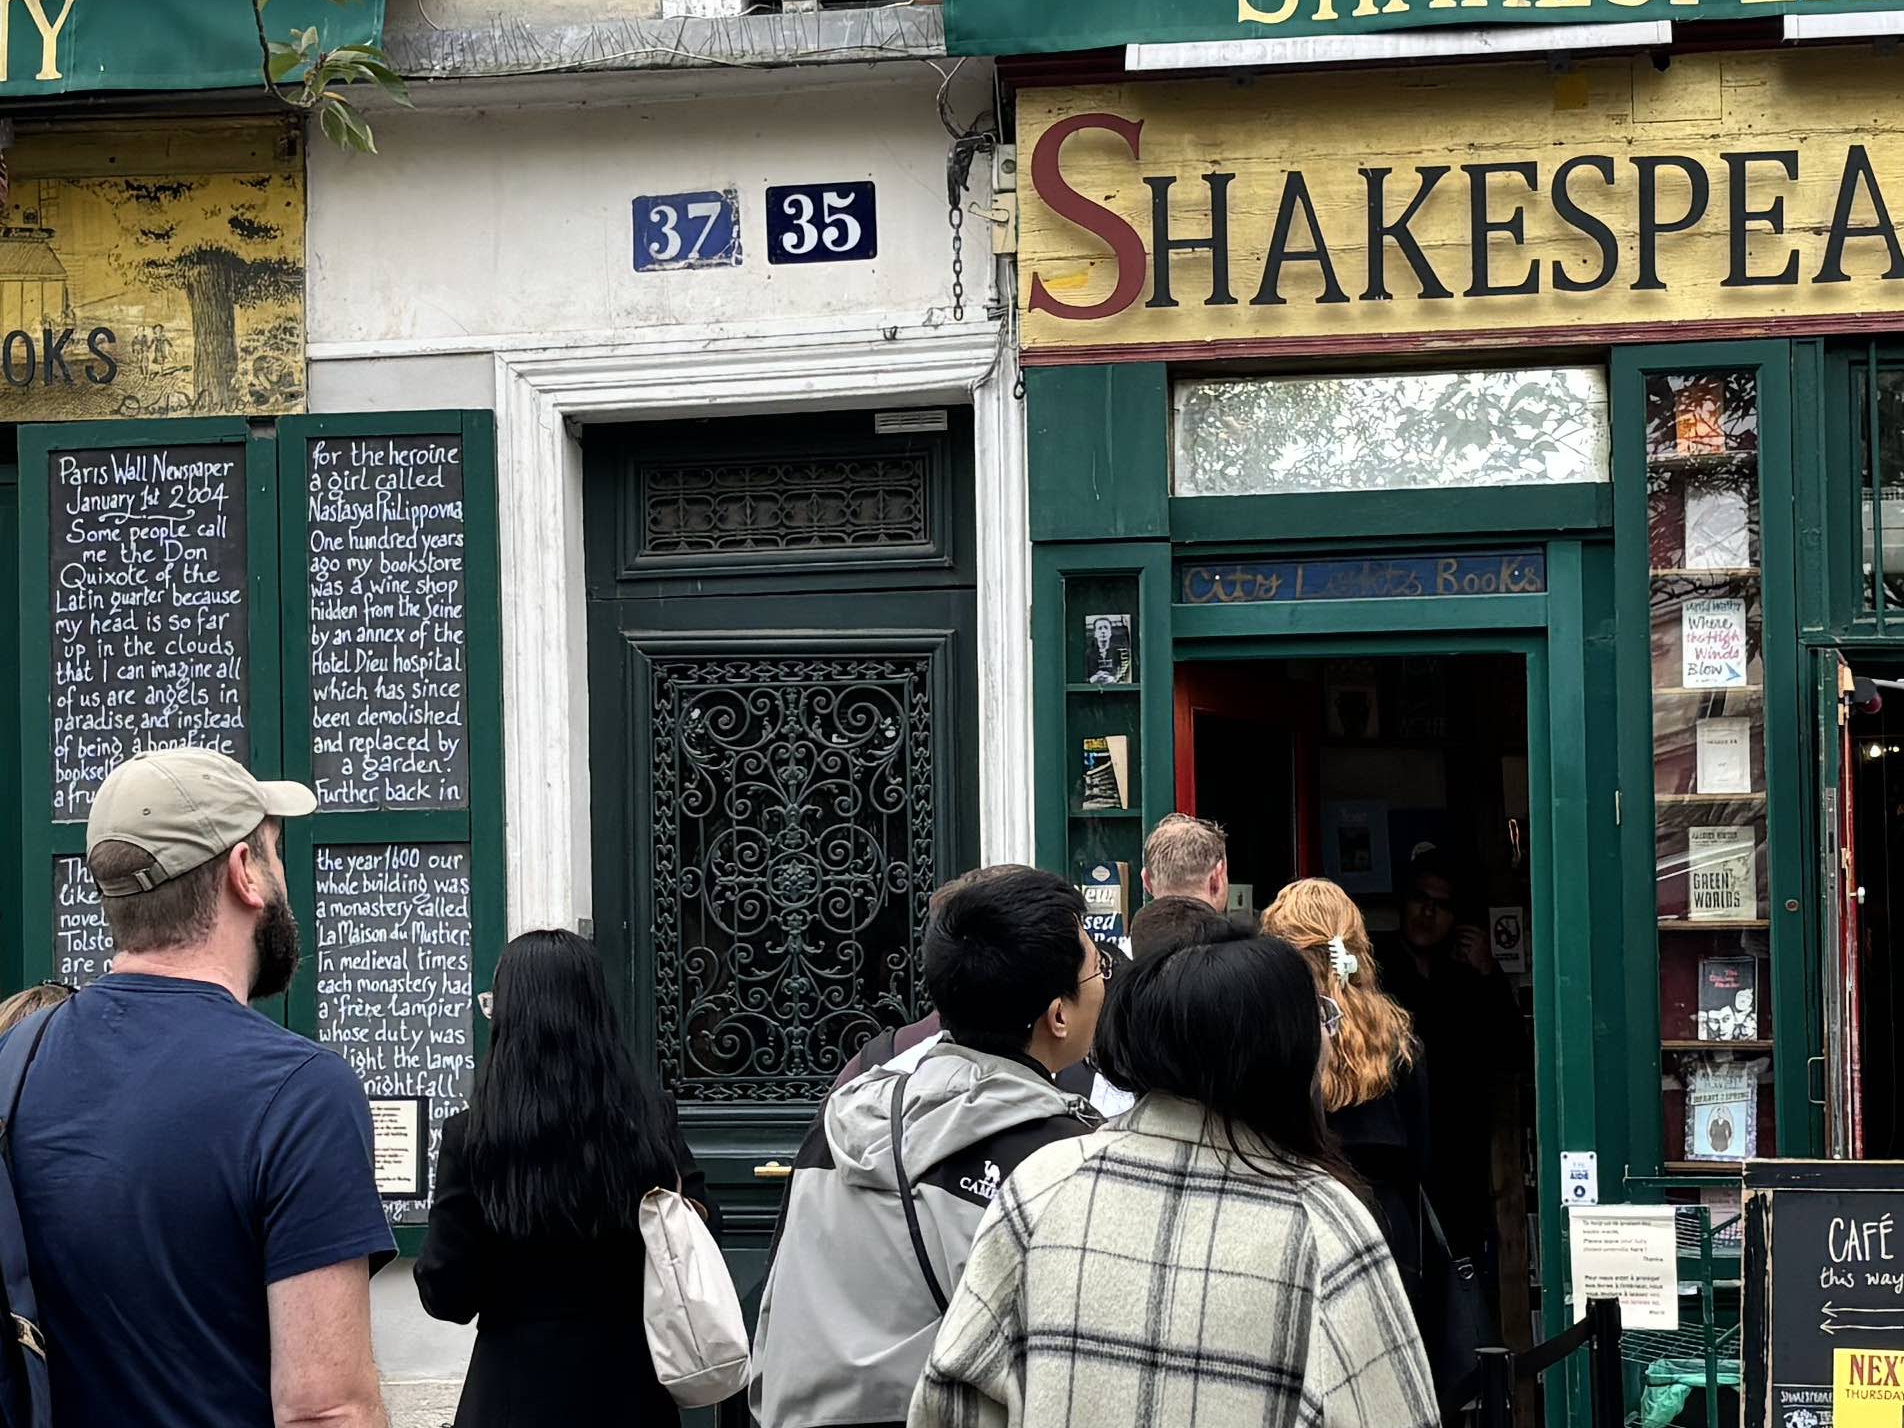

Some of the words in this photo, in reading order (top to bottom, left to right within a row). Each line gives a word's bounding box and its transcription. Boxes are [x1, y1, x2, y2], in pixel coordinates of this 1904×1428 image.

[649, 202, 721, 261] 37
[782, 191, 861, 254] 35
[59, 456, 108, 485] Paris
[111, 453, 146, 485] Wall
[152, 451, 234, 490] Newspaper
[313, 441, 342, 470] for
[352, 442, 383, 466] the
[389, 441, 459, 466] heroine
[310, 474, 321, 491] a
[328, 467, 370, 500] girl
[375, 465, 445, 490] called
[66, 487, 135, 519] January
[140, 485, 160, 510] 1st
[169, 483, 229, 511] 2004
[309, 492, 373, 529] Nastasya
[66, 519, 121, 543] Some
[130, 519, 191, 549] people
[197, 515, 226, 538] call
[311, 530, 344, 552] One
[349, 526, 418, 550] hundred
[422, 534, 464, 559] years
[83, 549, 106, 563] me
[121, 543, 156, 563] the
[164, 540, 207, 562] Don
[60, 563, 148, 590] Quixote
[156, 563, 174, 589] of
[184, 564, 220, 584] the
[1435, 558, 1542, 595] Books
[56, 590, 104, 614] Latin
[110, 587, 164, 615] quarter
[173, 584, 242, 606] because
[56, 619, 83, 643] my
[90, 609, 138, 635] head
[146, 611, 161, 632] is
[169, 615, 191, 631] so
[197, 606, 230, 636] far
[1688, 615, 1733, 630] Where
[316, 848, 343, 870] the
[347, 854, 382, 875] year
[385, 845, 419, 870] 1600
[428, 854, 464, 869] our
[316, 873, 359, 895] whole
[363, 873, 430, 904] building
[434, 877, 469, 894] was
[1693, 872, 1729, 890] GREEN
[316, 903, 326, 918] a
[331, 894, 413, 927] monastery
[417, 896, 469, 917] called
[1694, 891, 1741, 909] WORLDS
[1828, 1213, 1894, 1263] CAFÉ
[1820, 1267, 1854, 1288] this
[1867, 1273, 1904, 1294] way
